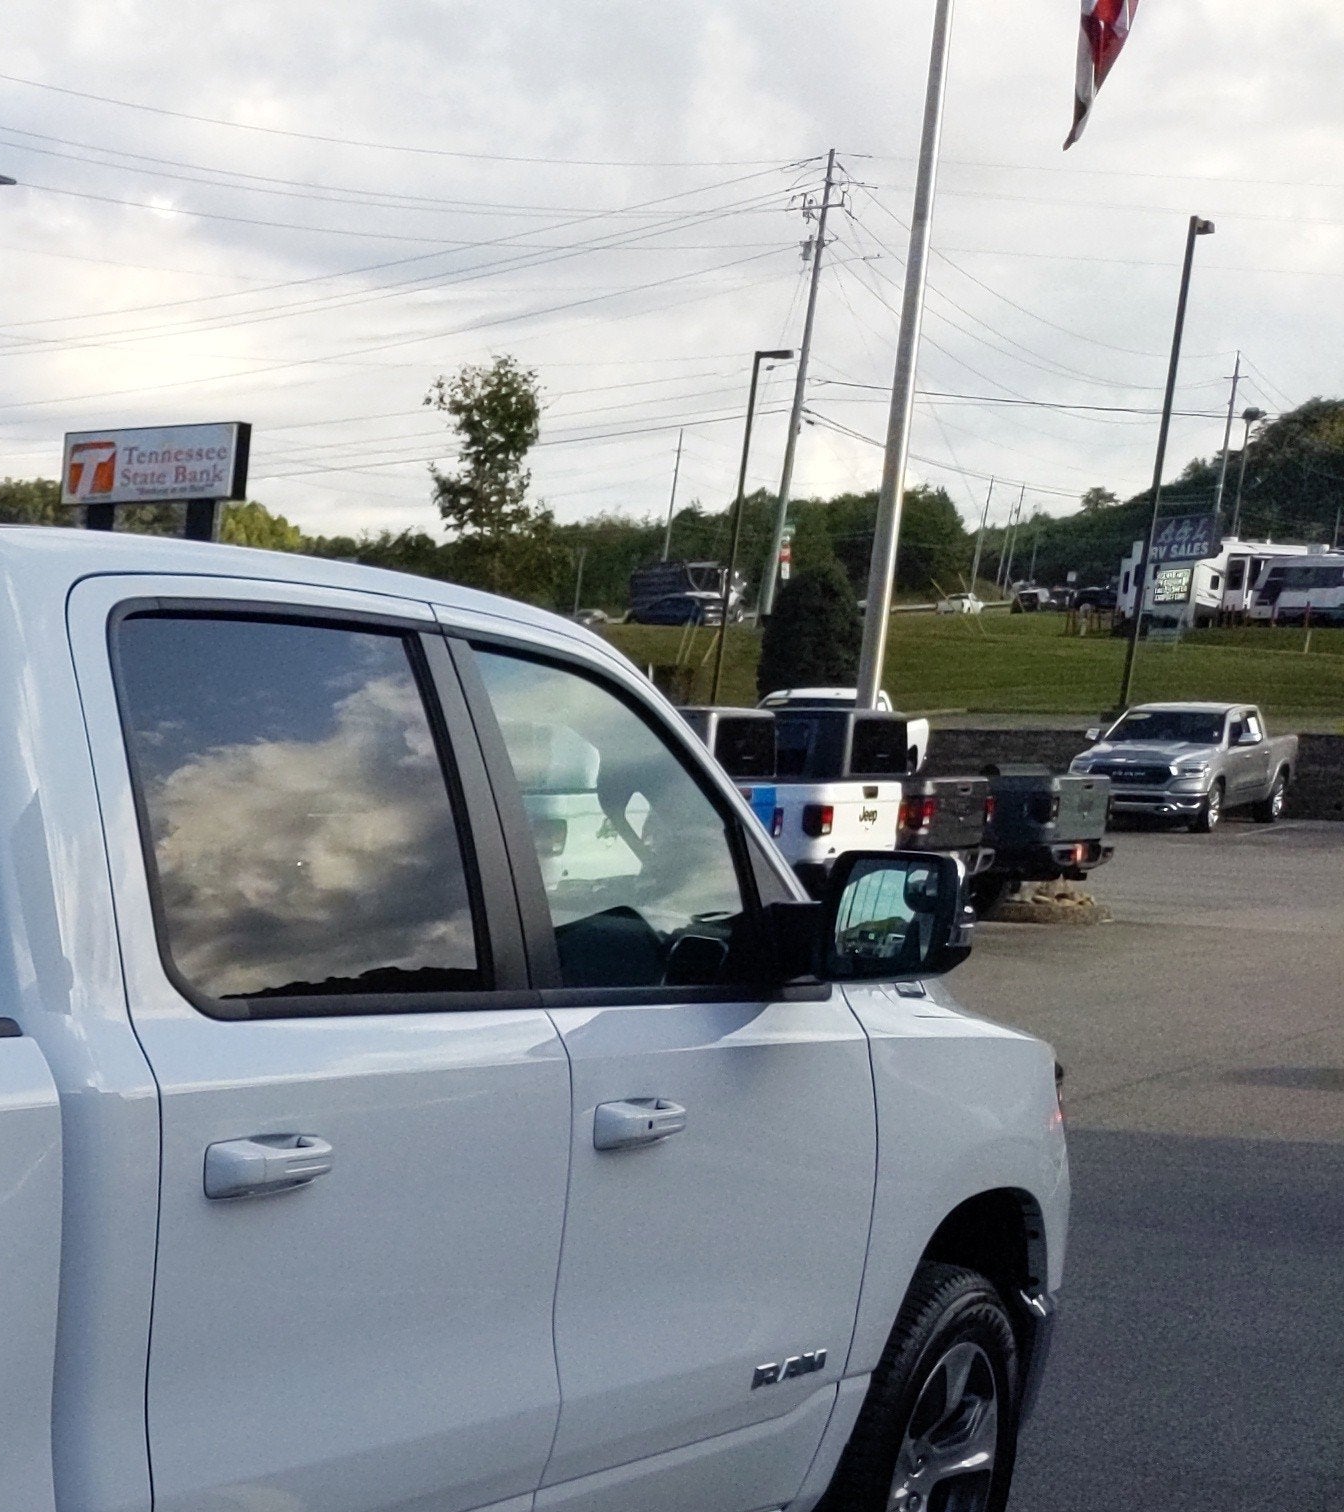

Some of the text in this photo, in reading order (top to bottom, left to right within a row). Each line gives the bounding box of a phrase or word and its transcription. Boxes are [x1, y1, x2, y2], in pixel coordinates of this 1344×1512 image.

[123, 444, 228, 465] Tennessee
[119, 469, 167, 487] State
[173, 464, 225, 485] Bank
[1170, 542, 1209, 558] SALES
[859, 806, 878, 825] Jeep
